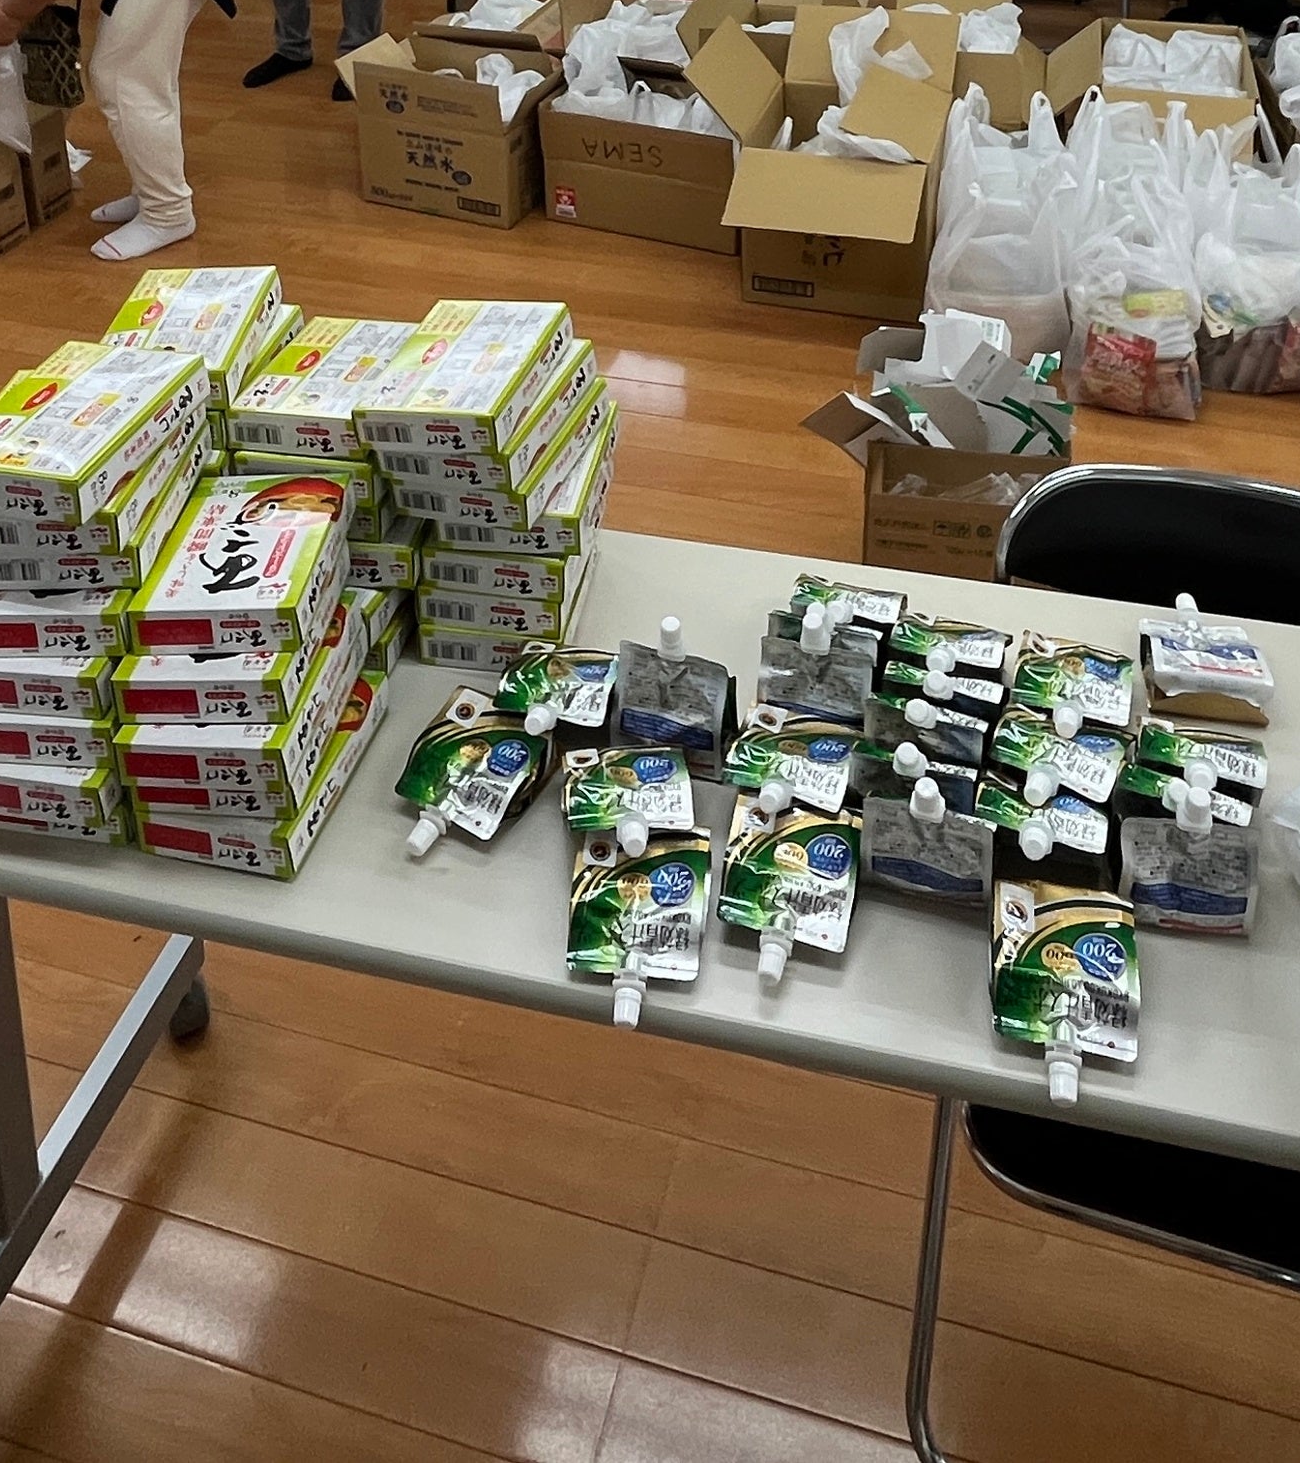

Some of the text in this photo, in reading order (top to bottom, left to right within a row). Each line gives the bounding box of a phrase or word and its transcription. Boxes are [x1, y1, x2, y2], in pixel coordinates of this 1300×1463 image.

[405, 150, 455, 173] 天然水
[582, 138, 663, 168] SEMA
[199, 504, 278, 595] あさげ
[814, 843, 846, 859] 200
[1081, 940, 1117, 957] 200
